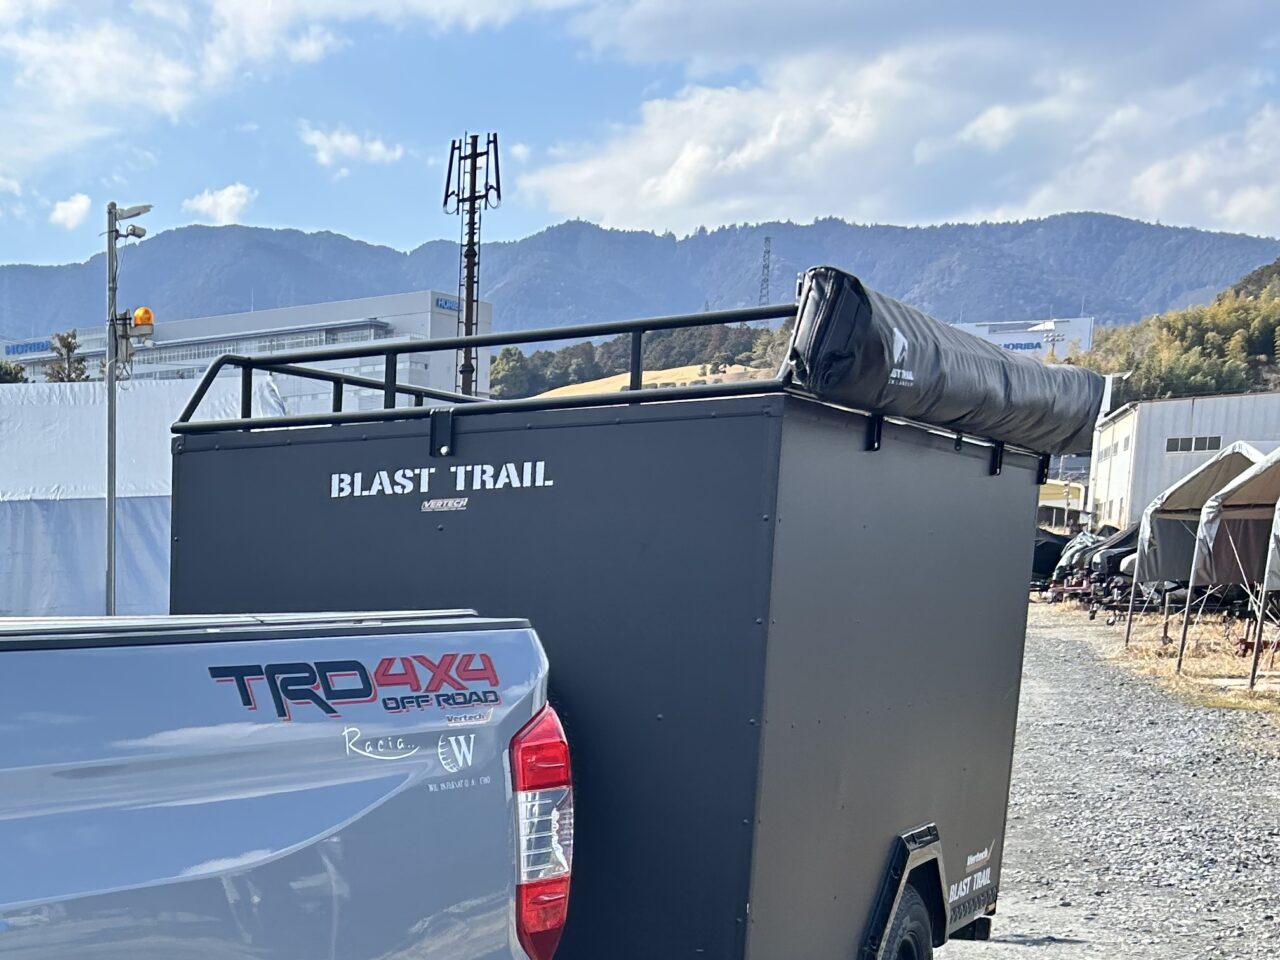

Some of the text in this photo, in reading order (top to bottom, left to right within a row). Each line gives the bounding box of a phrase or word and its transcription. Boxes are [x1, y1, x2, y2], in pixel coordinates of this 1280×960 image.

[331, 461, 554, 498] BLAST TRAIL
[423, 498, 468, 508] VERTECH
[208, 660, 377, 721] TRD
[381, 690, 501, 713] OFF ROAD
[949, 867, 991, 903] BLAST TRAIL
